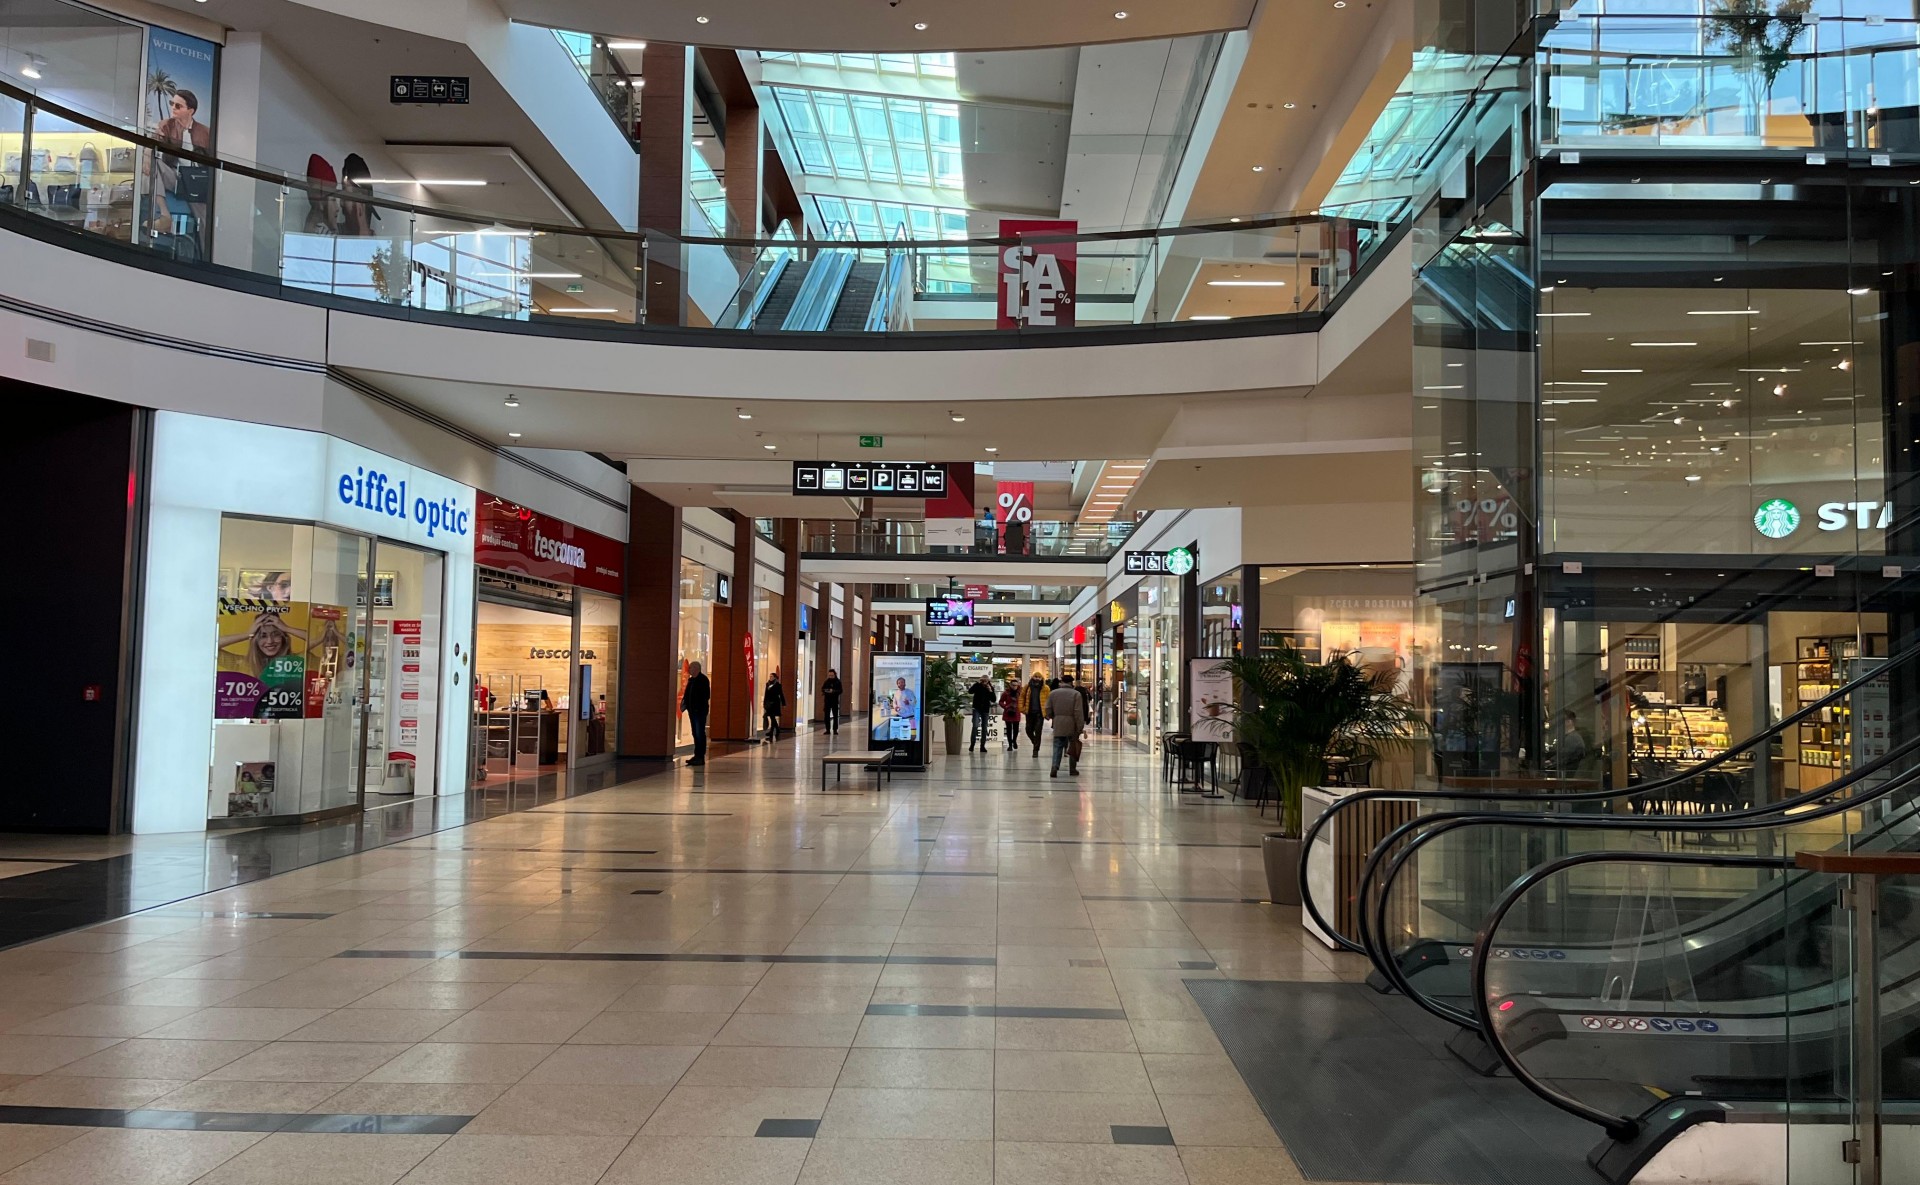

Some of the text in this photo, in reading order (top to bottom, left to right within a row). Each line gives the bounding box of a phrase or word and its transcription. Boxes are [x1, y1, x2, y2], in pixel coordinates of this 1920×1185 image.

[152, 38, 212, 62] WITTCHEN
[877, 473, 888, 486] P
[925, 475, 940, 485] WC
[338, 465, 468, 538] eiffel optic
[534, 529, 587, 570] tescoma.
[529, 646, 597, 660] tescoa.
[268, 660, 304, 673] -50%
[217, 681, 260, 697] -70%
[261, 691, 302, 706] -50%
